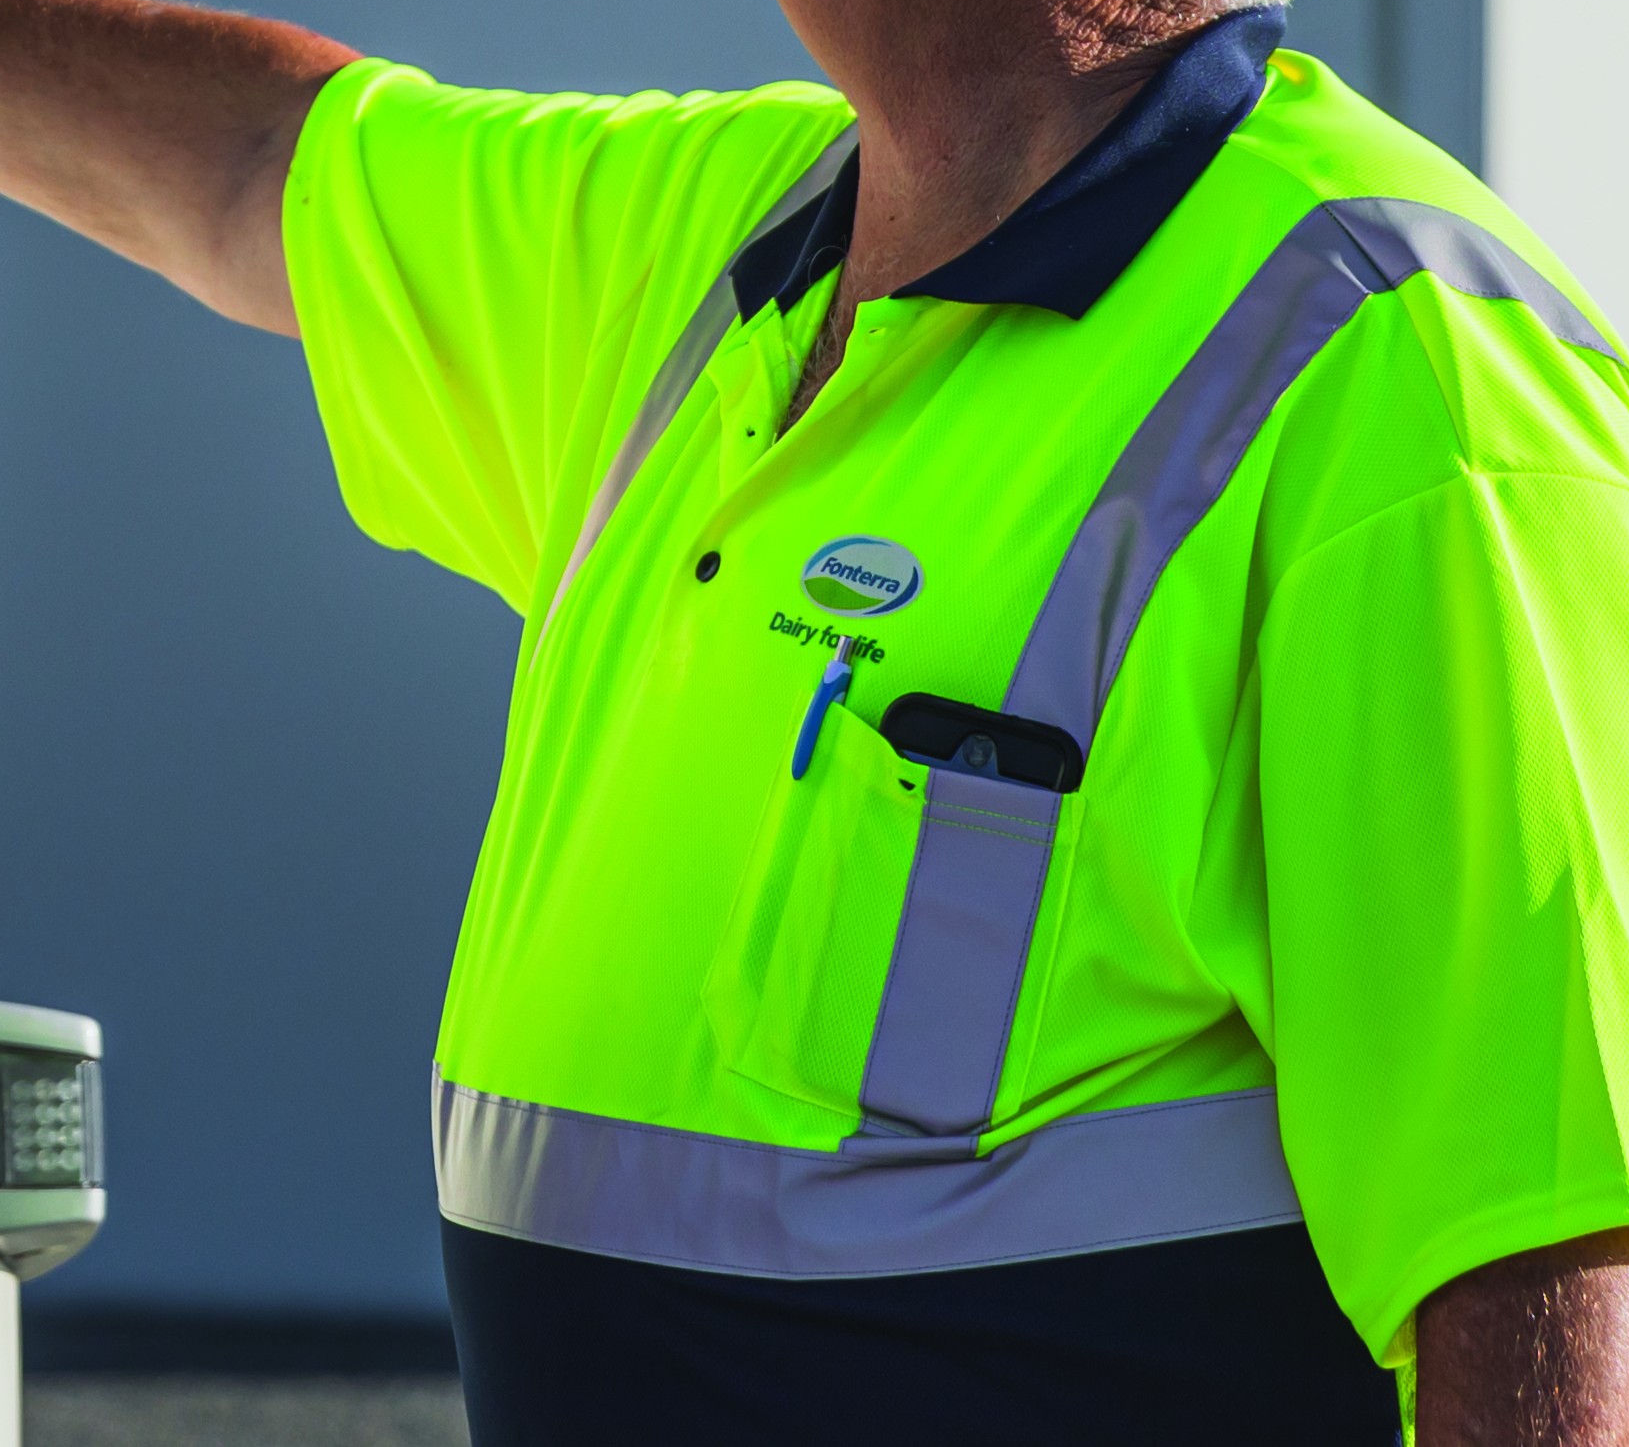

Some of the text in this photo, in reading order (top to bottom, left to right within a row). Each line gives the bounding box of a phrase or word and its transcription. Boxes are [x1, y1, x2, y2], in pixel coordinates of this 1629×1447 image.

[820, 557, 901, 594] Fonterra
[768, 611, 886, 664] Dairy fo life
